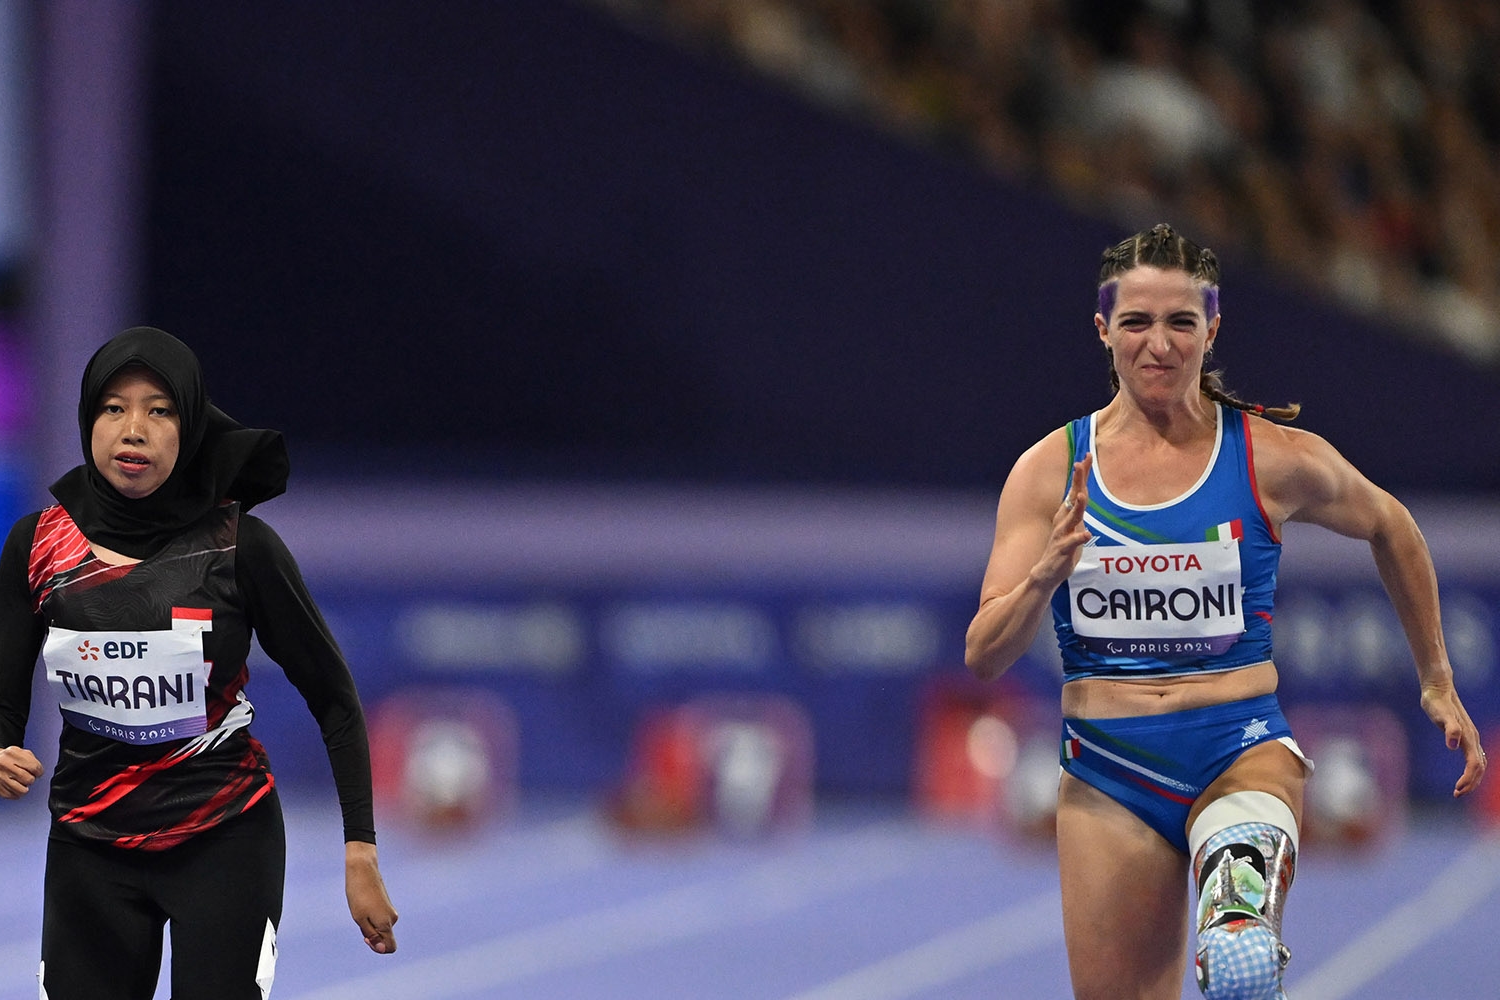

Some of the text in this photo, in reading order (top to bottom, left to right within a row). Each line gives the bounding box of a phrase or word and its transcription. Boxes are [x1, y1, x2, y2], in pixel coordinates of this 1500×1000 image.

[1099, 553, 1203, 575] TOYOTA
[1076, 583, 1236, 622] CAIRONI
[1130, 642, 1212, 653] PARIS 2024
[55, 669, 195, 710] TIARANI
[104, 725, 176, 741] PARIS 2024
